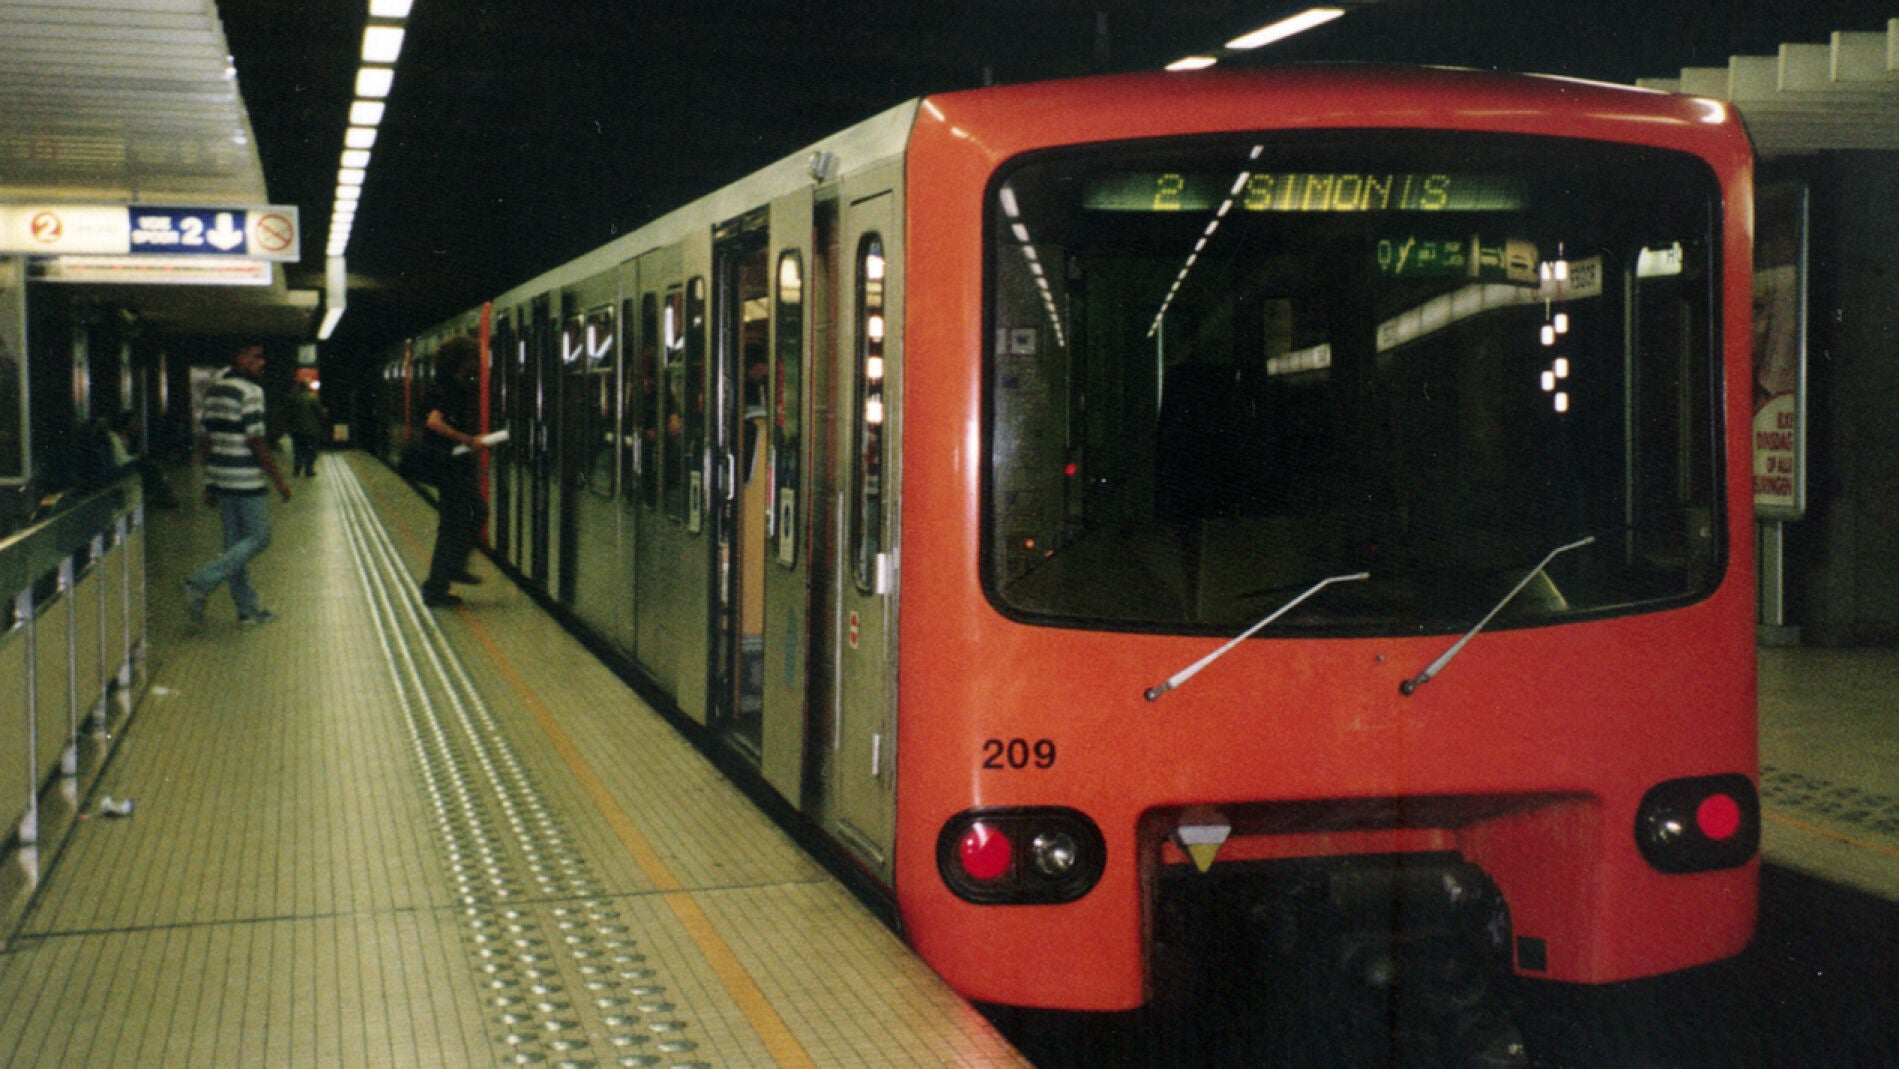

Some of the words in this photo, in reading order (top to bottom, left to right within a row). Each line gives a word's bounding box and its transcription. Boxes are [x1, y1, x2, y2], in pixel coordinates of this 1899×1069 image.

[1152, 173, 1184, 211] 2
[1244, 173, 1450, 211] SIMONIS
[180, 216, 204, 245] 2
[982, 737, 1056, 770] 209
